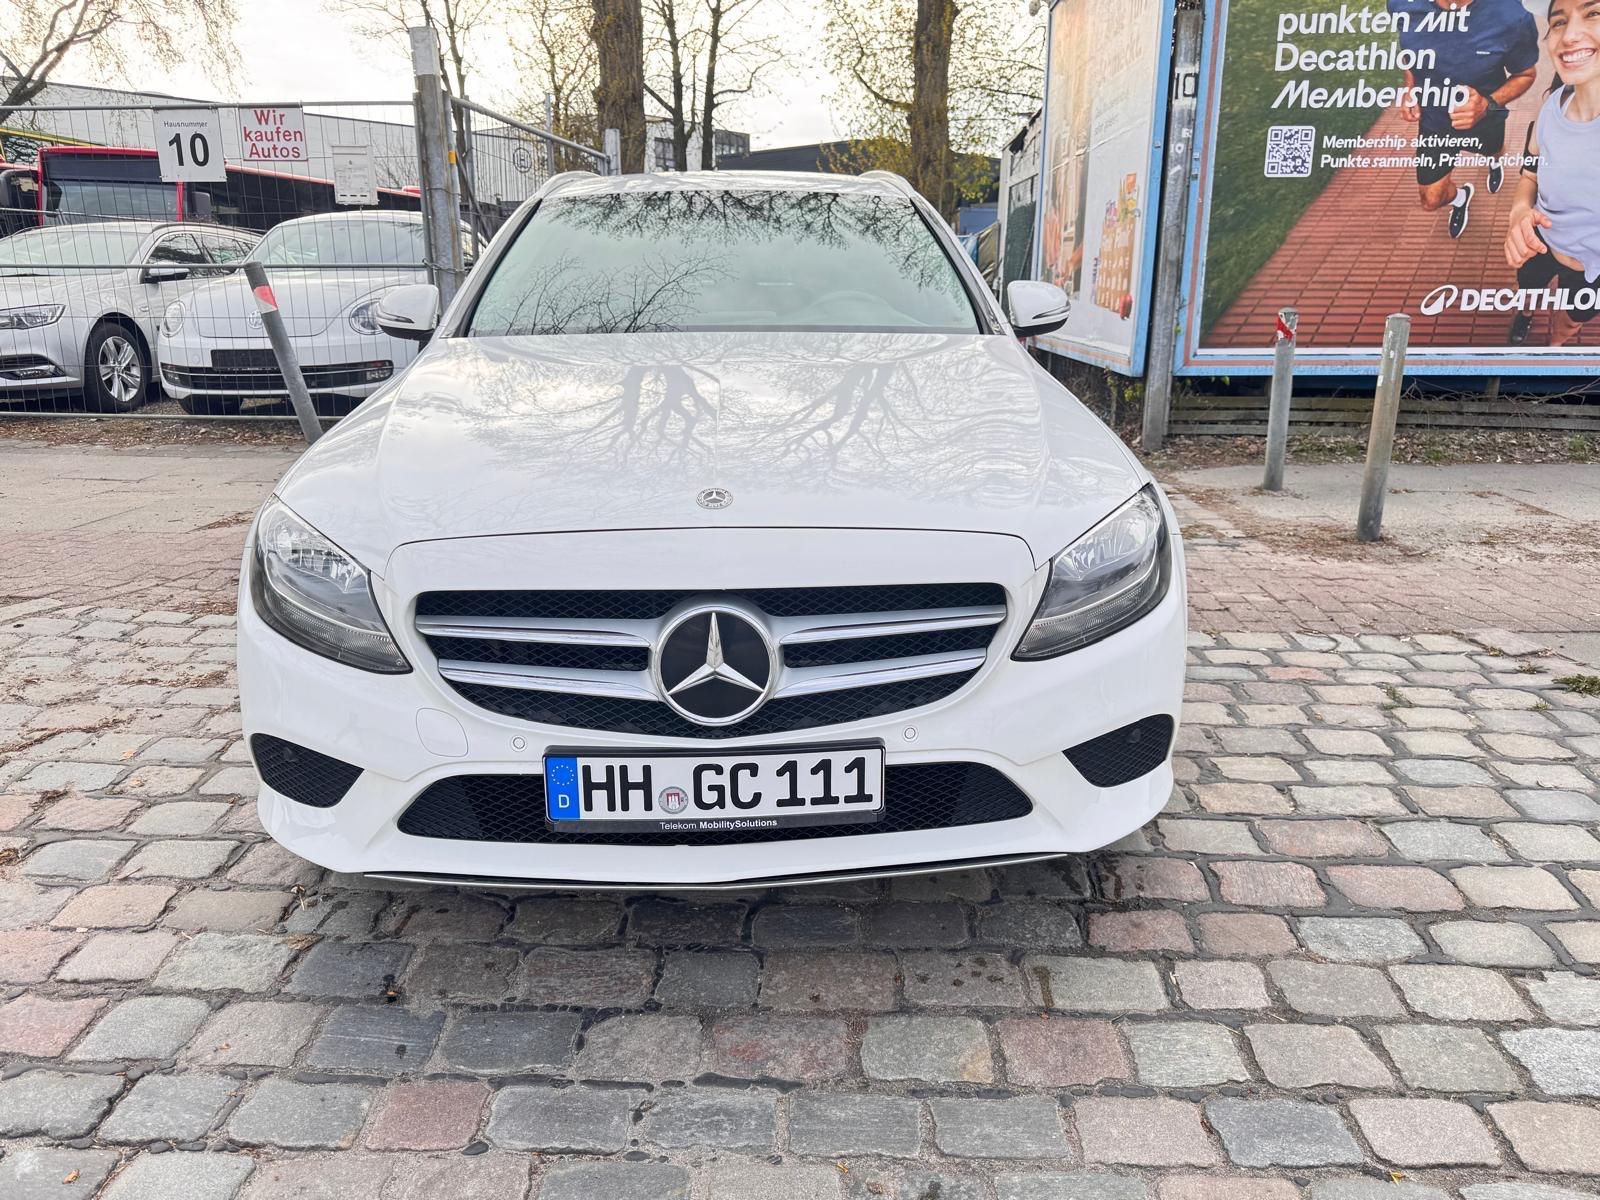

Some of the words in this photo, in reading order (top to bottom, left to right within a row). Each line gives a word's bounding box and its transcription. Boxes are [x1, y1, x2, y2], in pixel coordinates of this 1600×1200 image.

[1277, 4, 1411, 42] punkten
[1274, 41, 1436, 72] Decathlon
[1270, 77, 1470, 114] Membership
[163, 120, 208, 128] Hausnummer
[254, 109, 286, 126] Wir
[243, 127, 304, 142] kaufen
[1322, 135, 1407, 150] Membership
[1410, 134, 1484, 150] aktivieren,
[168, 132, 210, 167] 10
[249, 143, 301, 159] Autos
[1320, 154, 1370, 168] Punkte
[1372, 153, 1436, 169] sammeln,
[1438, 153, 1495, 167] Prämien
[1498, 152, 1549, 167] sichern.
[581, 764, 653, 812] HH
[692, 761, 763, 810] GC
[775, 756, 874, 808] 111
[557, 795, 570, 808] D
[659, 821, 697, 830] Telekom
[699, 818, 778, 831] MobilitySolutions
